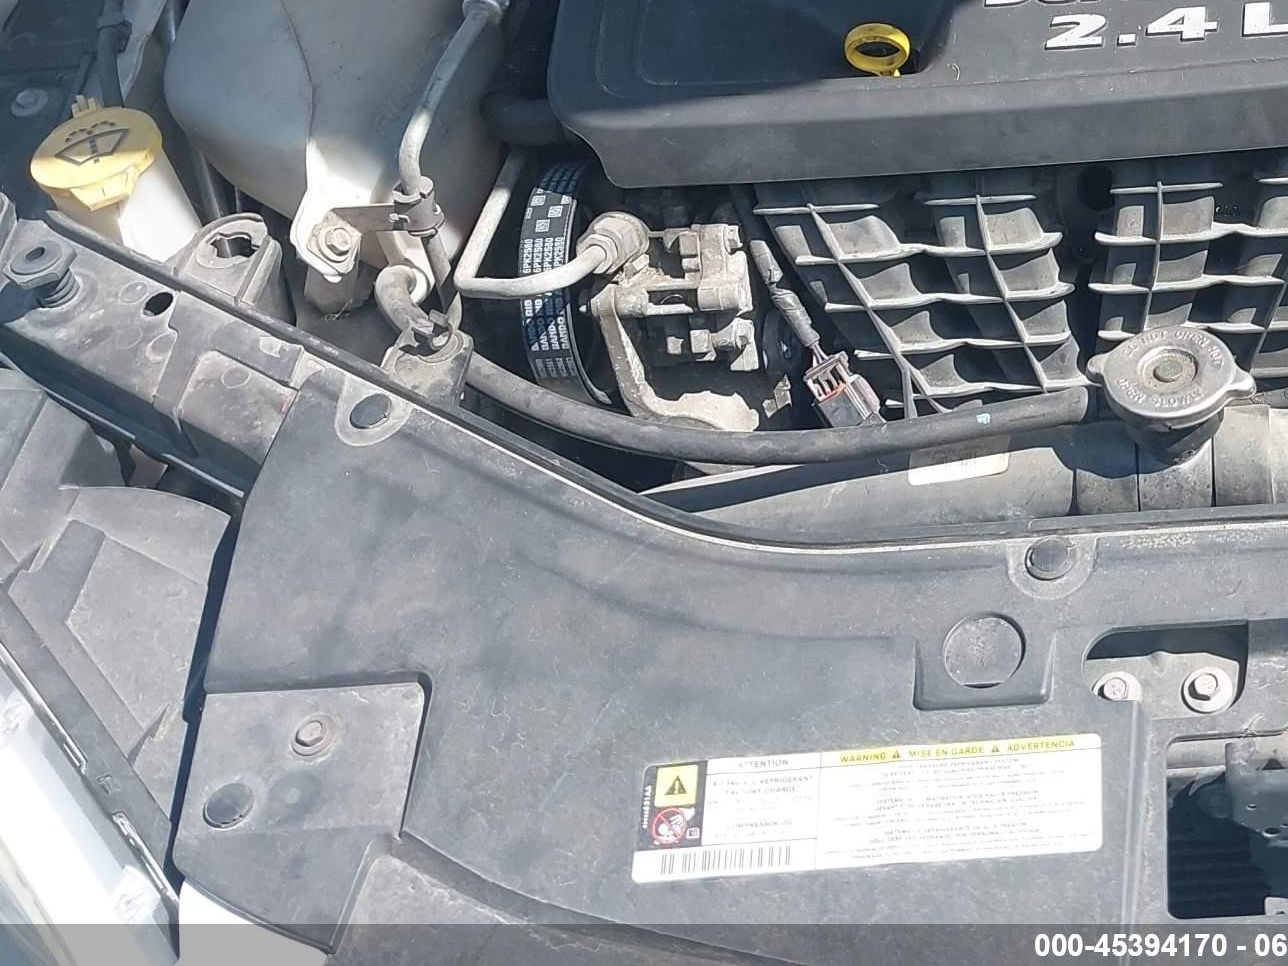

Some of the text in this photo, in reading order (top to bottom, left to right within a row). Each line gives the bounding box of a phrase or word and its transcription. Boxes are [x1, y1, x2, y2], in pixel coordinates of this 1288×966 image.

[1044, 5, 1218, 51] 2.4
[537, 317, 550, 351] BANDO
[546, 316, 561, 350] BANDO
[556, 316, 570, 350] BANDO
[738, 759, 790, 769] ATTENTION
[840, 752, 887, 763] WARNING
[908, 749, 932, 758] MISE
[936, 748, 948, 756] EN
[951, 745, 985, 755] GARDE
[1007, 740, 1076, 752] ADVERTENCIA
